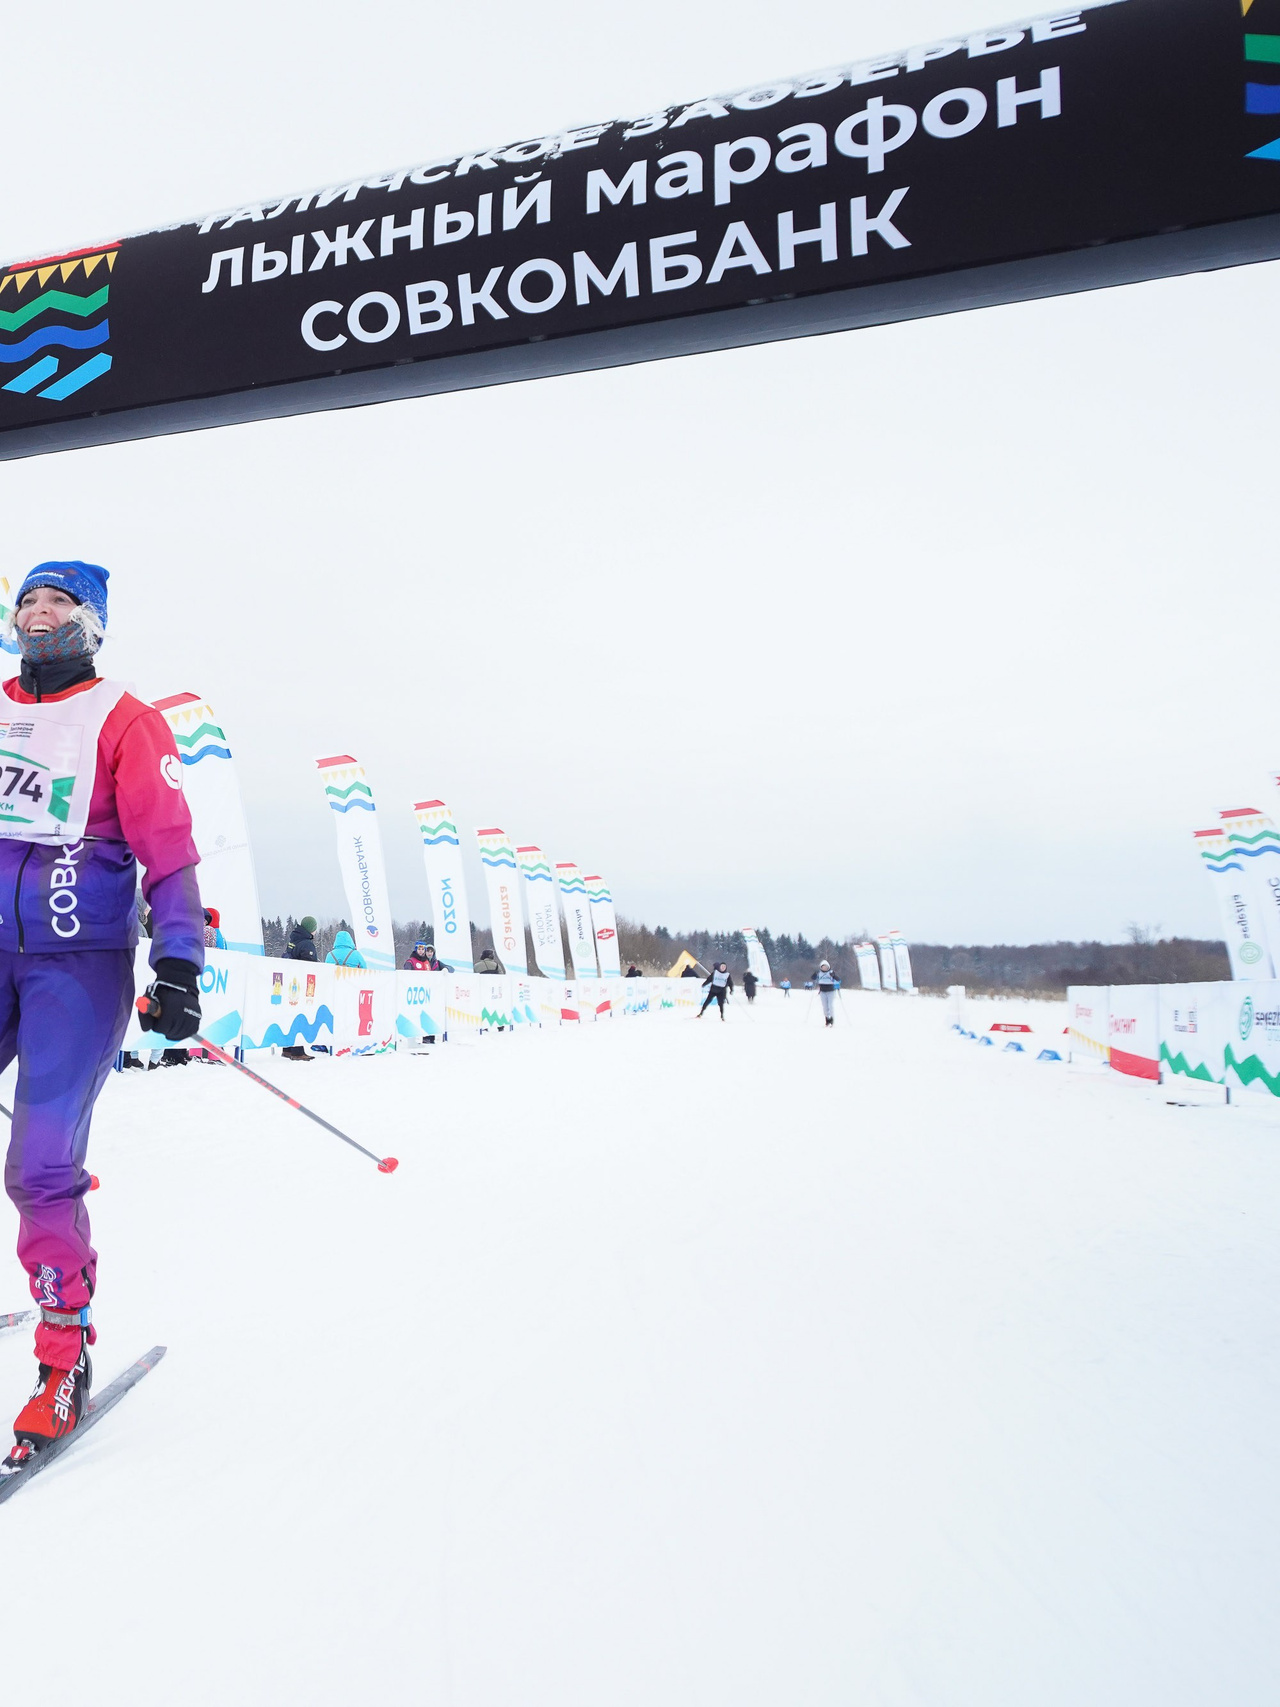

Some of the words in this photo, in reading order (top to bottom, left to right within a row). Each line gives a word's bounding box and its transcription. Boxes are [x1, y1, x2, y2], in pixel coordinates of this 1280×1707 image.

[201, 172, 552, 293] ЛЫЖНЫЙ
[586, 66, 1061, 214] марафон
[301, 187, 912, 351] СОВКОМБАНК
[49, 841, 84, 938] СОВК
[199, 965, 228, 995] ON
[407, 986, 430, 1005] OZON
